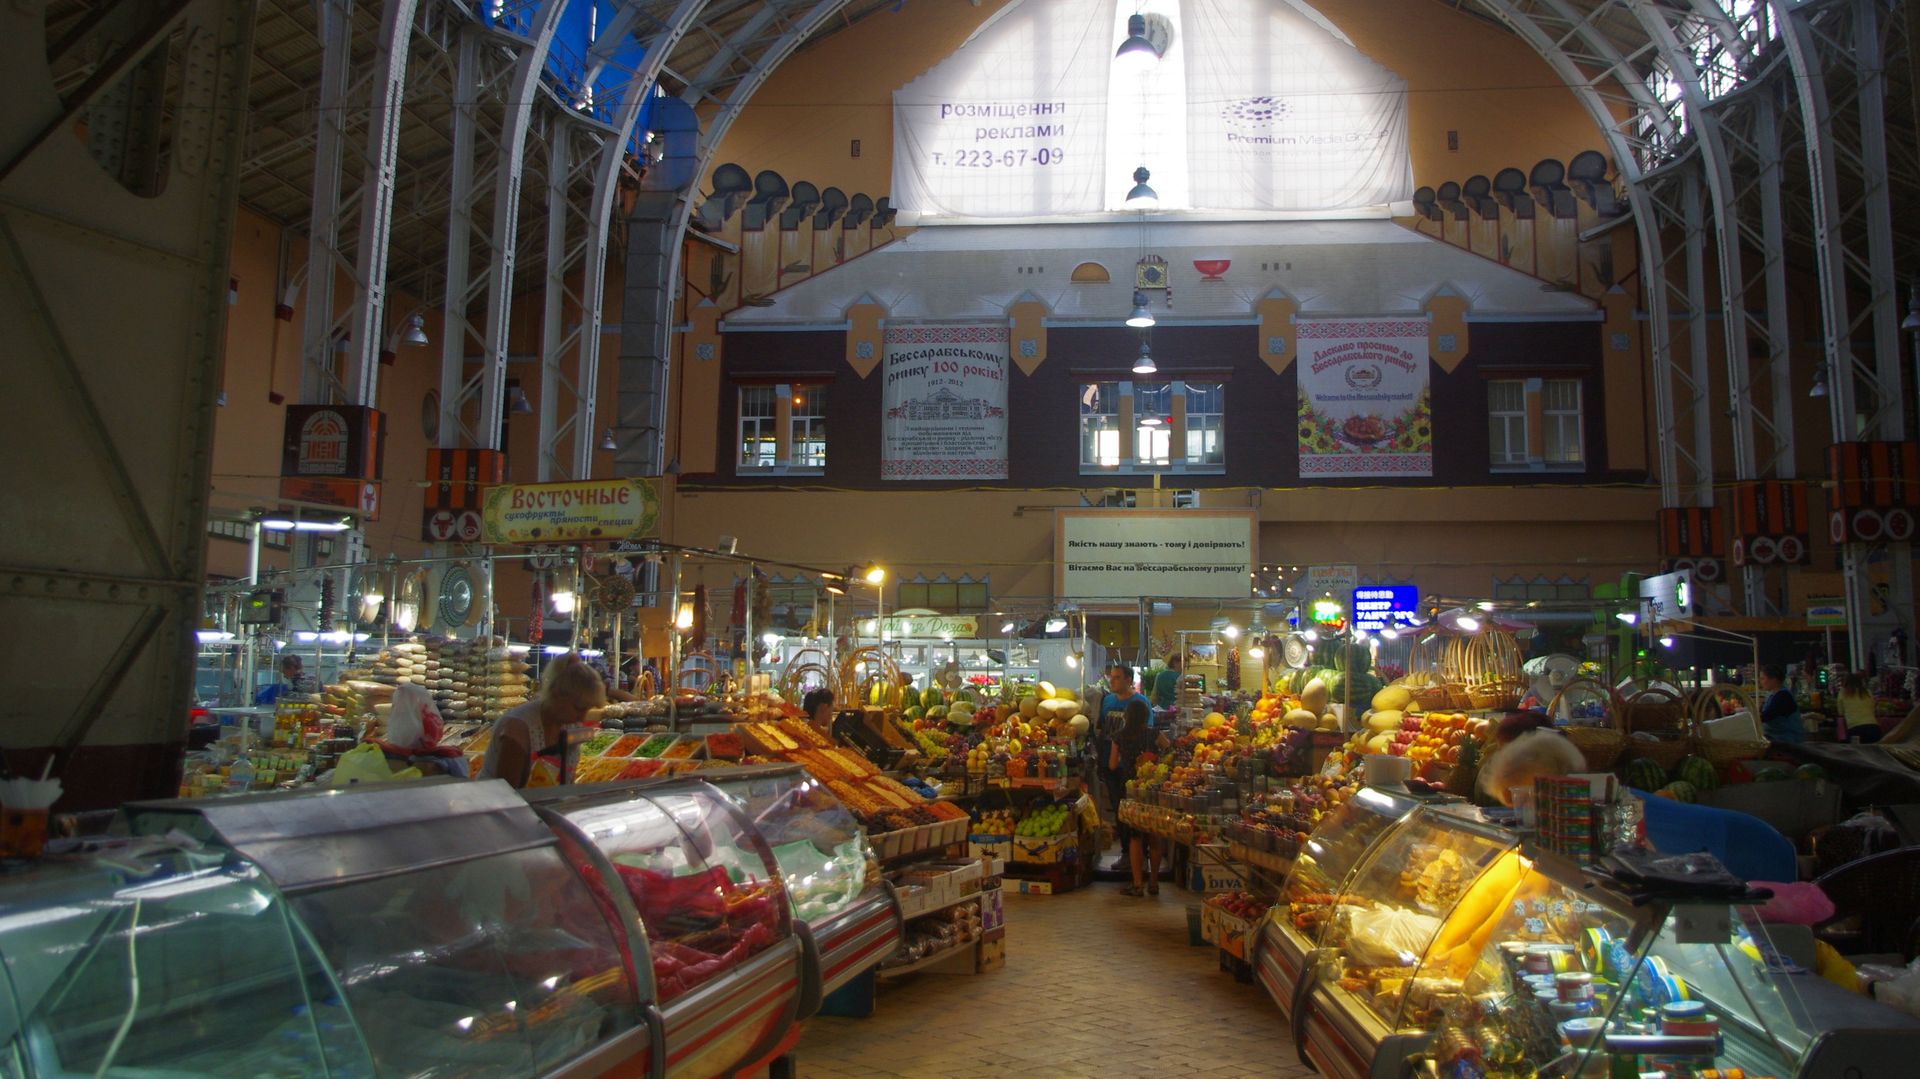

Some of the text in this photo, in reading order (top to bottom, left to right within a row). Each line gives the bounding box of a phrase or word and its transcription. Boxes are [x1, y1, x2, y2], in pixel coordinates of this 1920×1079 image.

[941, 102, 1065, 119] розміщення
[975, 124, 1064, 142] реклами
[1227, 133, 1296, 145] Premium
[1299, 134, 1343, 145] Media
[932, 147, 1064, 168] т. 223-67-09
[1357, 341, 1399, 354] просимо
[889, 347, 1004, 368] Бессарабському
[888, 361, 1004, 387] ринку 100 років!
[504, 510, 566, 522] сухофрукты
[550, 514, 599, 525] пряности
[598, 518, 633, 527] специи
[1068, 540, 1098, 548] Якість
[1099, 541, 1122, 549] нашу
[1165, 541, 1187, 549] тому
[1193, 540, 1245, 549] довіряють!
[1213, 565, 1245, 573] ринку!
[1356, 601, 1392, 611] ЦЕНТР
[1210, 879, 1242, 889] DIVA
